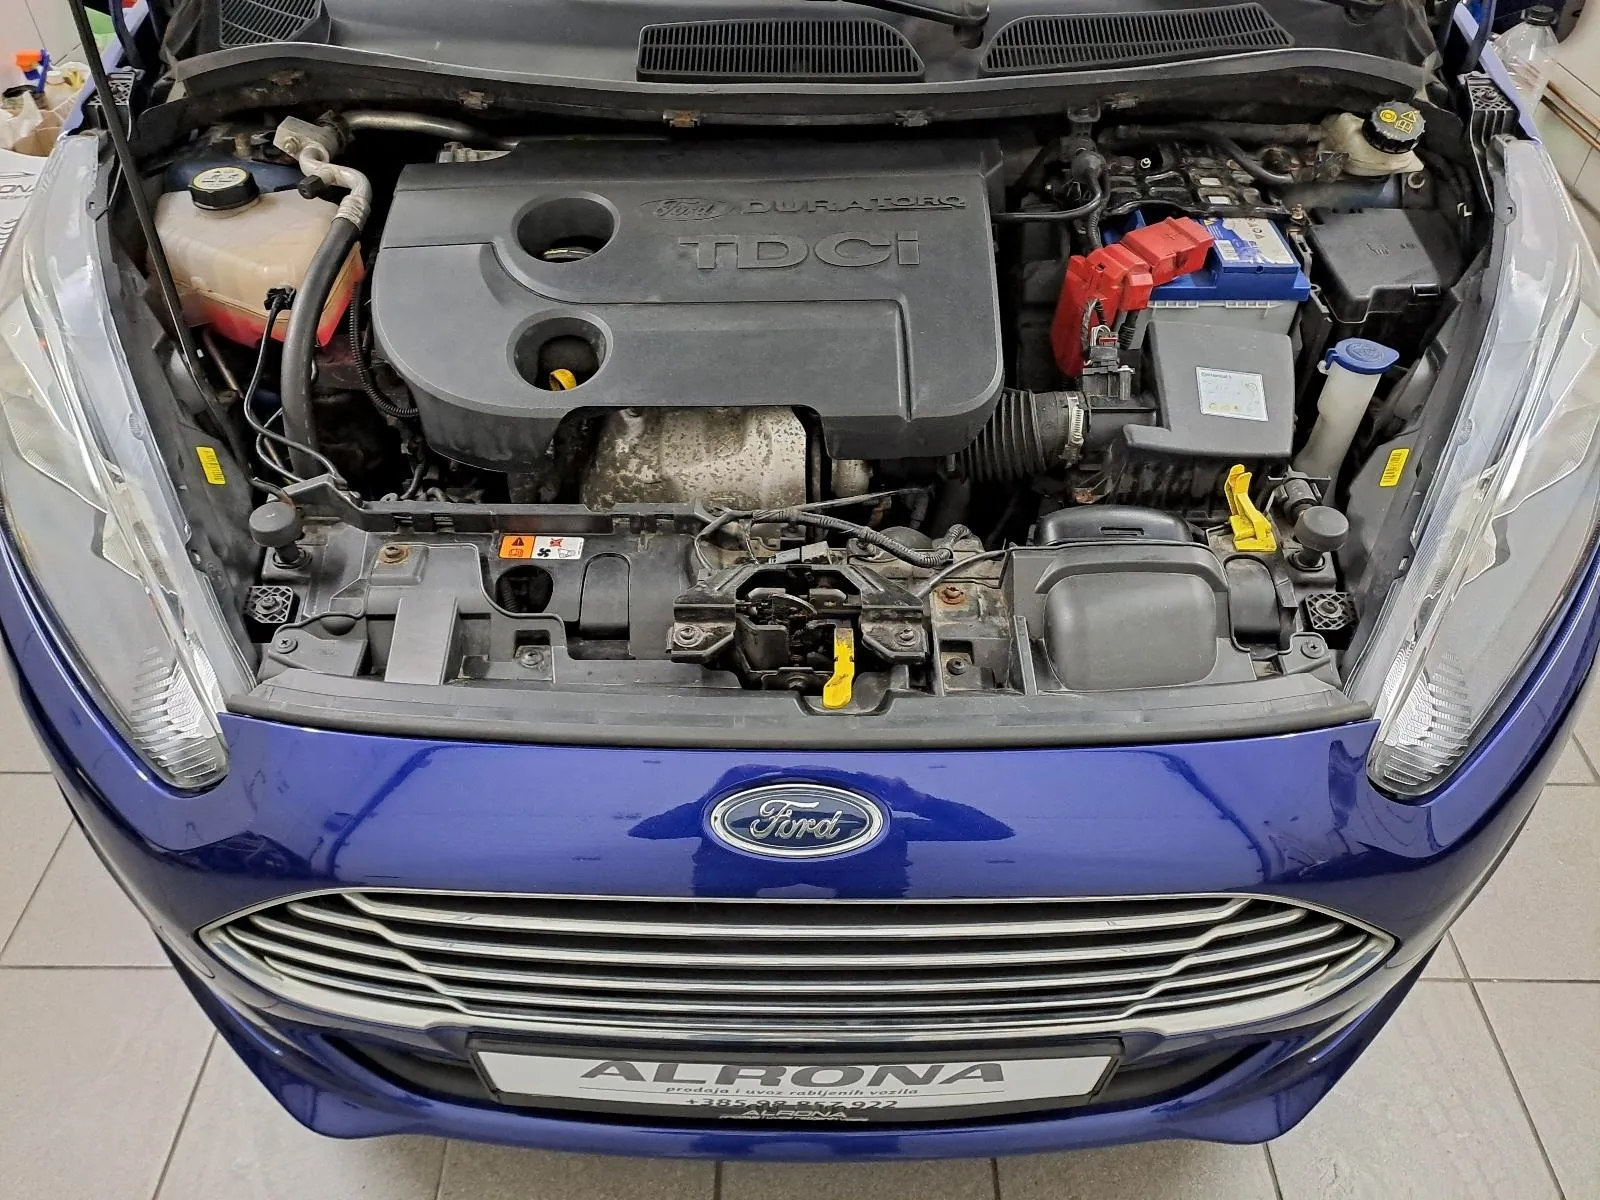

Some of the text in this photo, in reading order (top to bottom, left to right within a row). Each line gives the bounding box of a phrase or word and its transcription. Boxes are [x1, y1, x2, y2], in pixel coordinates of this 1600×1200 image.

[653, 198, 718, 219] Ford
[750, 799, 842, 839] Ford
[580, 1061, 1004, 1087] ALRONA
[666, 1086, 729, 1095] prodaja
[789, 1088, 863, 1097] rabljenih
[870, 1088, 919, 1096] vozila
[685, 1098, 747, 1107] +385
[740, 1109, 848, 1117] ALRONA
